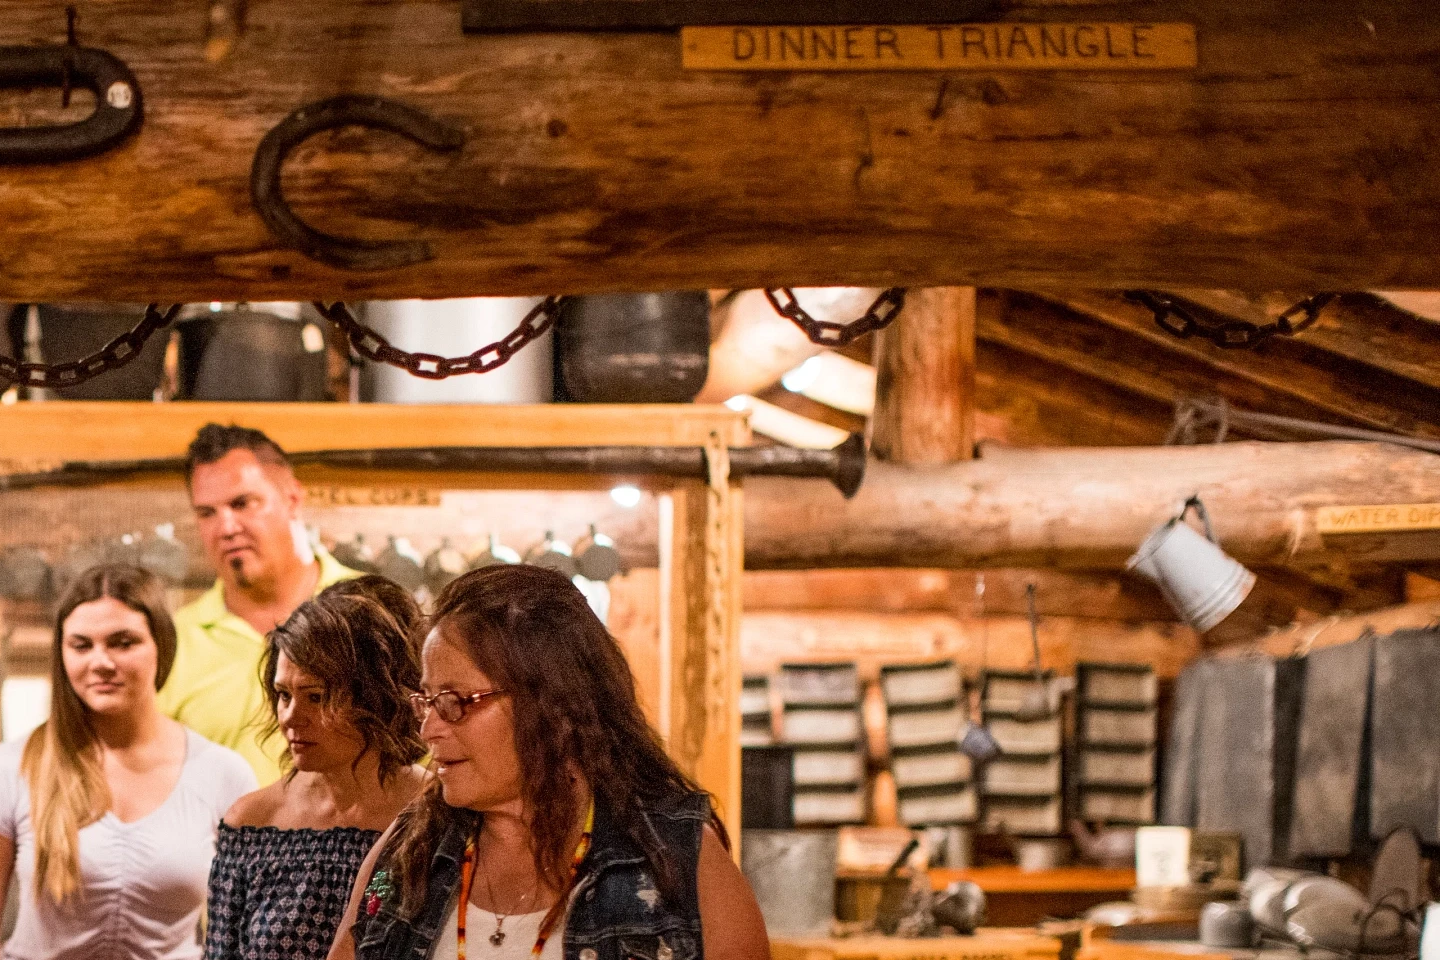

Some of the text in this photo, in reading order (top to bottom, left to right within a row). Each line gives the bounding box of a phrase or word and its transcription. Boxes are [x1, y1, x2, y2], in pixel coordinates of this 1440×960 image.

[732, 24, 1156, 62] DINNER TRIANGLE
[1329, 508, 1400, 526] WATER
